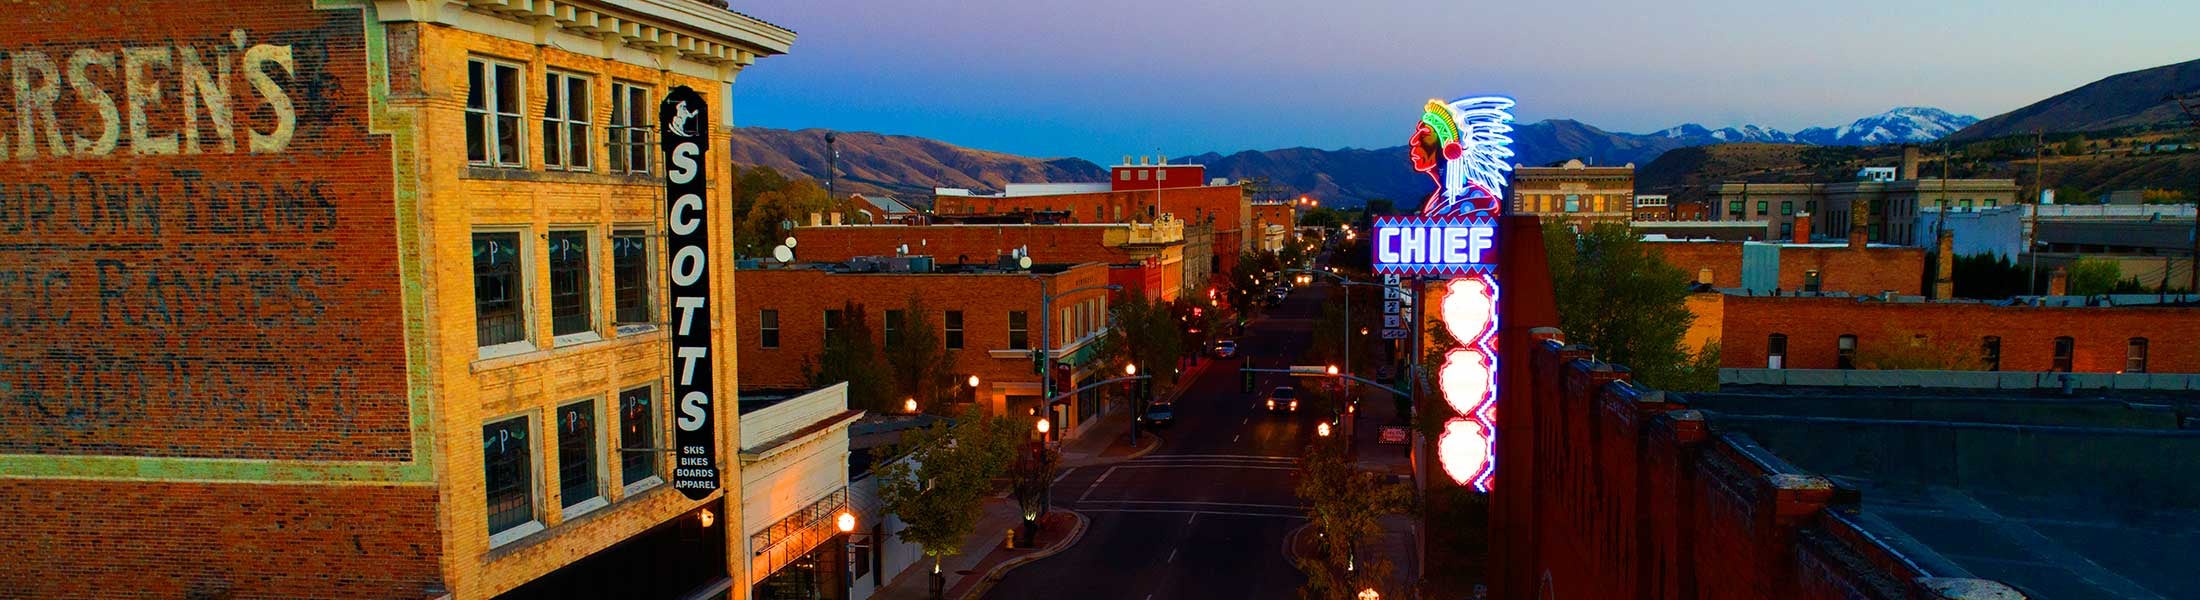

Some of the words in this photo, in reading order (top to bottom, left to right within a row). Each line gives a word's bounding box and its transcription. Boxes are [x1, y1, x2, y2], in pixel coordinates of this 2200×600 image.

[0, 29, 297, 161] RSEN'S
[1379, 227, 1494, 263] CHIEF
[669, 142, 709, 432] SCOTTS
[683, 445, 705, 455] SKIS
[681, 457, 709, 466] BIKES
[676, 468, 714, 478] BOARDS
[675, 480, 716, 489] APPAREL
